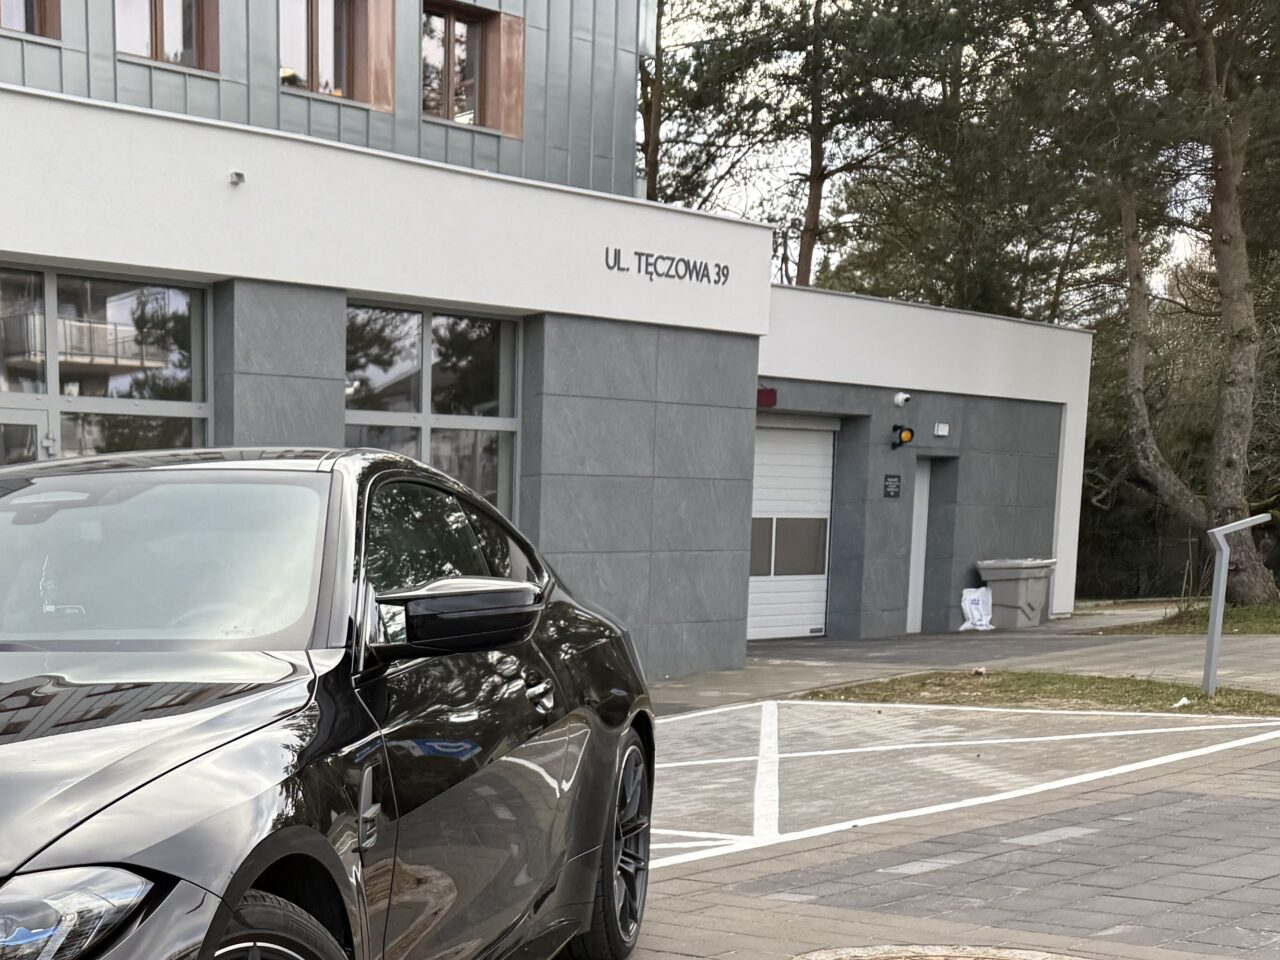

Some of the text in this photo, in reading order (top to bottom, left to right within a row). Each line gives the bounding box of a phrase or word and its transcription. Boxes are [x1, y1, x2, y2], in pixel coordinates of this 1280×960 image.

[605, 246, 730, 286] UL. TĘCZOWA 39
